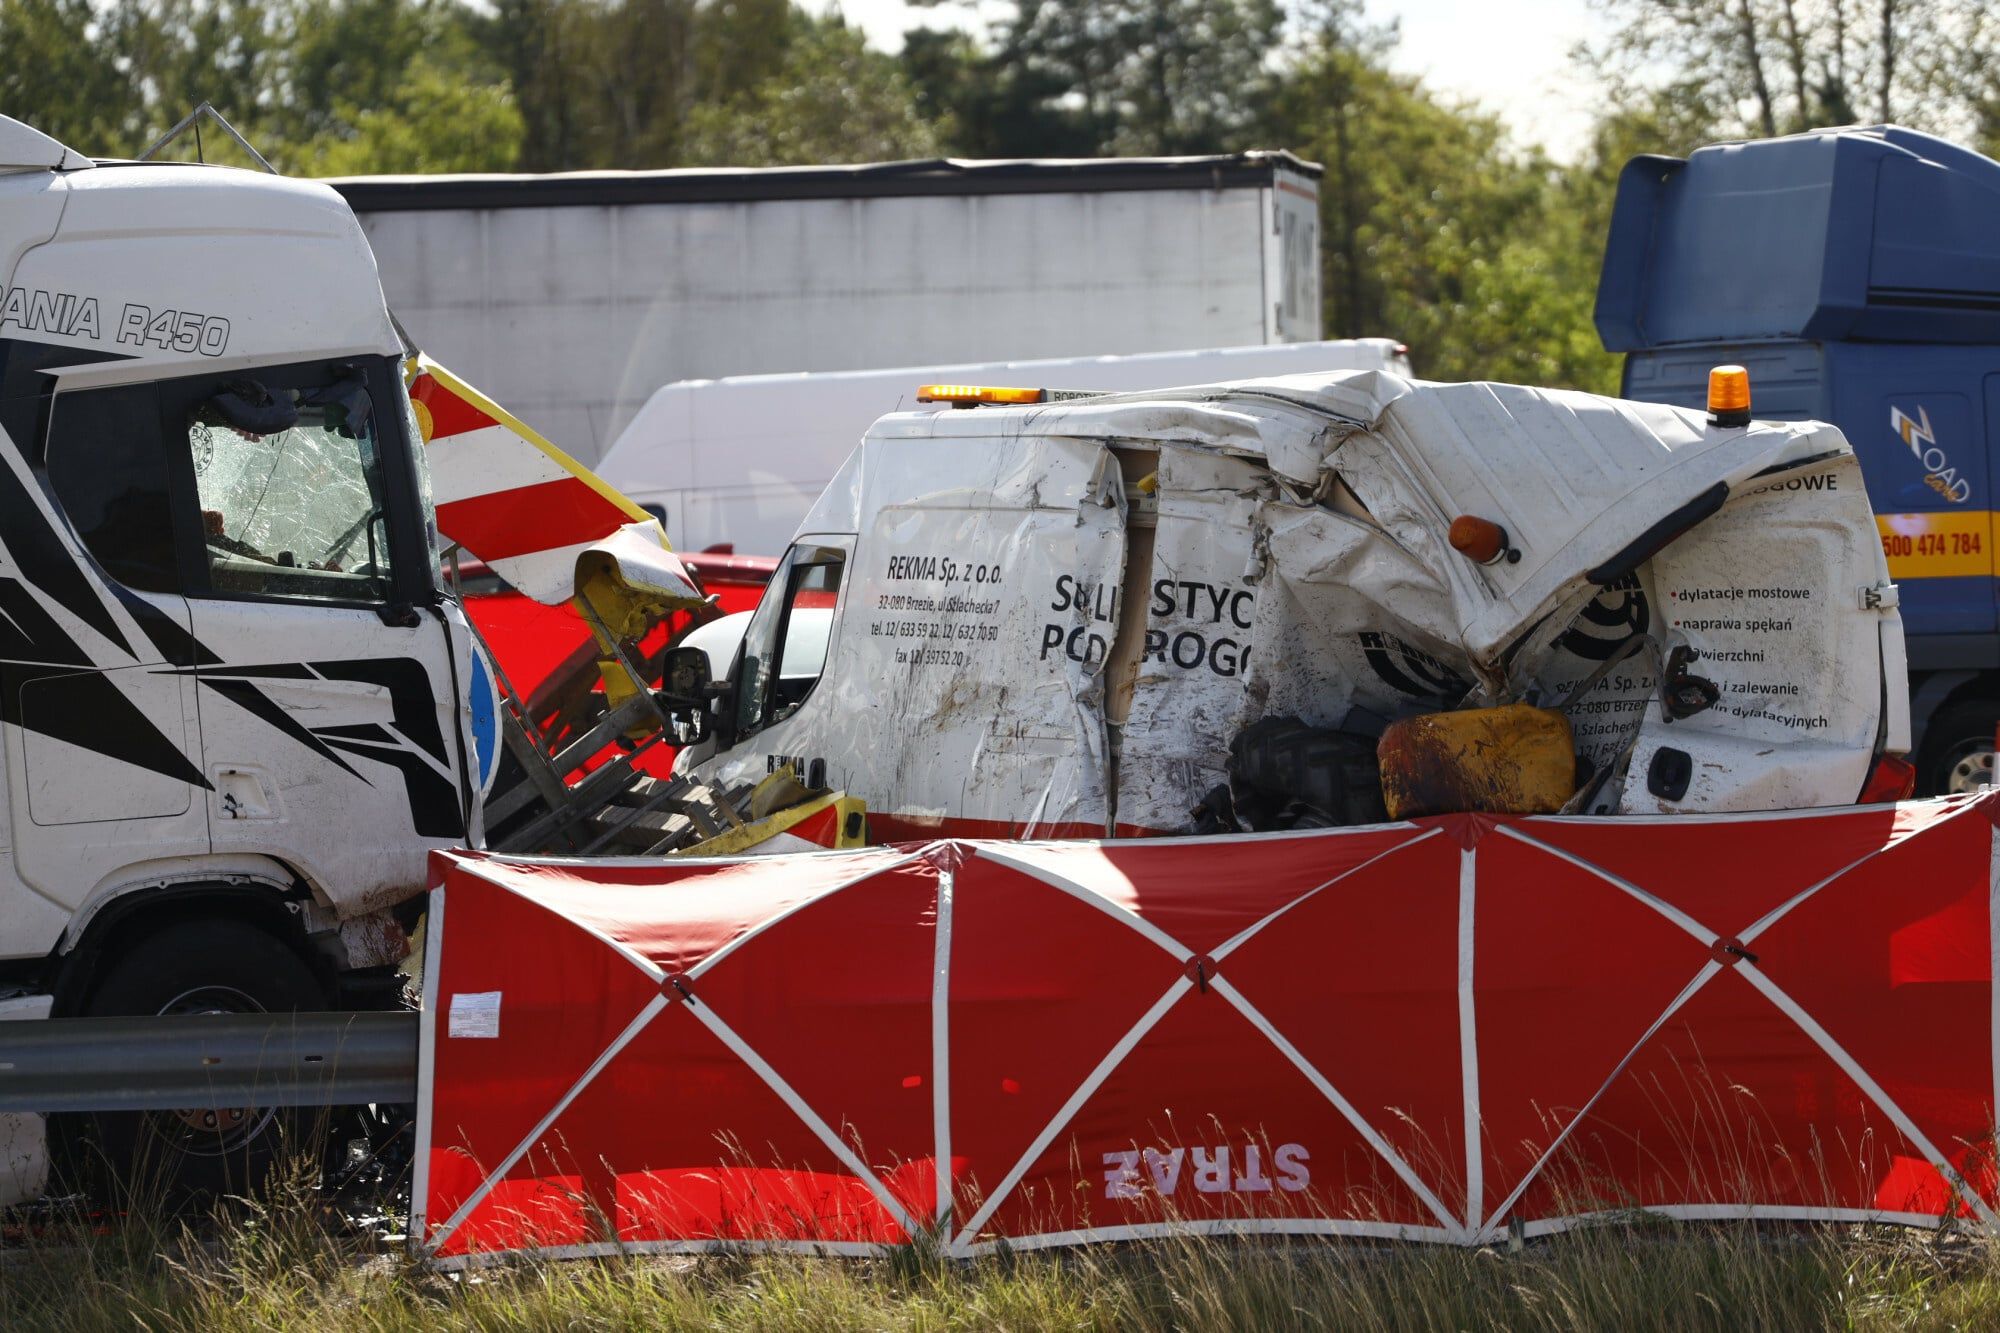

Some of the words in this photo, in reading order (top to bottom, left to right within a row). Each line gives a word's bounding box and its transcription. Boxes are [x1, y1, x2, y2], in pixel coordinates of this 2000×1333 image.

[0, 286, 100, 339] ANIA
[116, 303, 231, 357] R450
[1882, 535, 1912, 557] 500
[1917, 533, 1946, 556] 474
[1952, 532, 1981, 555] 784
[887, 556, 936, 580] REKMA
[939, 557, 959, 587] Sp.
[963, 563, 972, 582] z
[976, 564, 1002, 584] o.o.
[1679, 587, 1744, 603] dylatacje
[1748, 587, 1810, 600] mostowe
[878, 595, 905, 610] 32-080
[906, 596, 936, 614] Brzezie,
[871, 621, 883, 636] tel.
[885, 621, 900, 638] 12/
[900, 622, 915, 637] 633
[917, 622, 927, 638] 59
[958, 624, 975, 640] 632
[1683, 620, 1741, 631] naprawa
[1746, 618, 1792, 633] spękań
[895, 648, 907, 663] fax
[925, 650, 939, 665] 397
[940, 651, 950, 665] 52
[1614, 676, 1637, 693] Sp.
[1732, 681, 1799, 695] zalewanie
[1567, 701, 1610, 715] 32-080
[1732, 706, 1828, 730] dylatacyjnych
